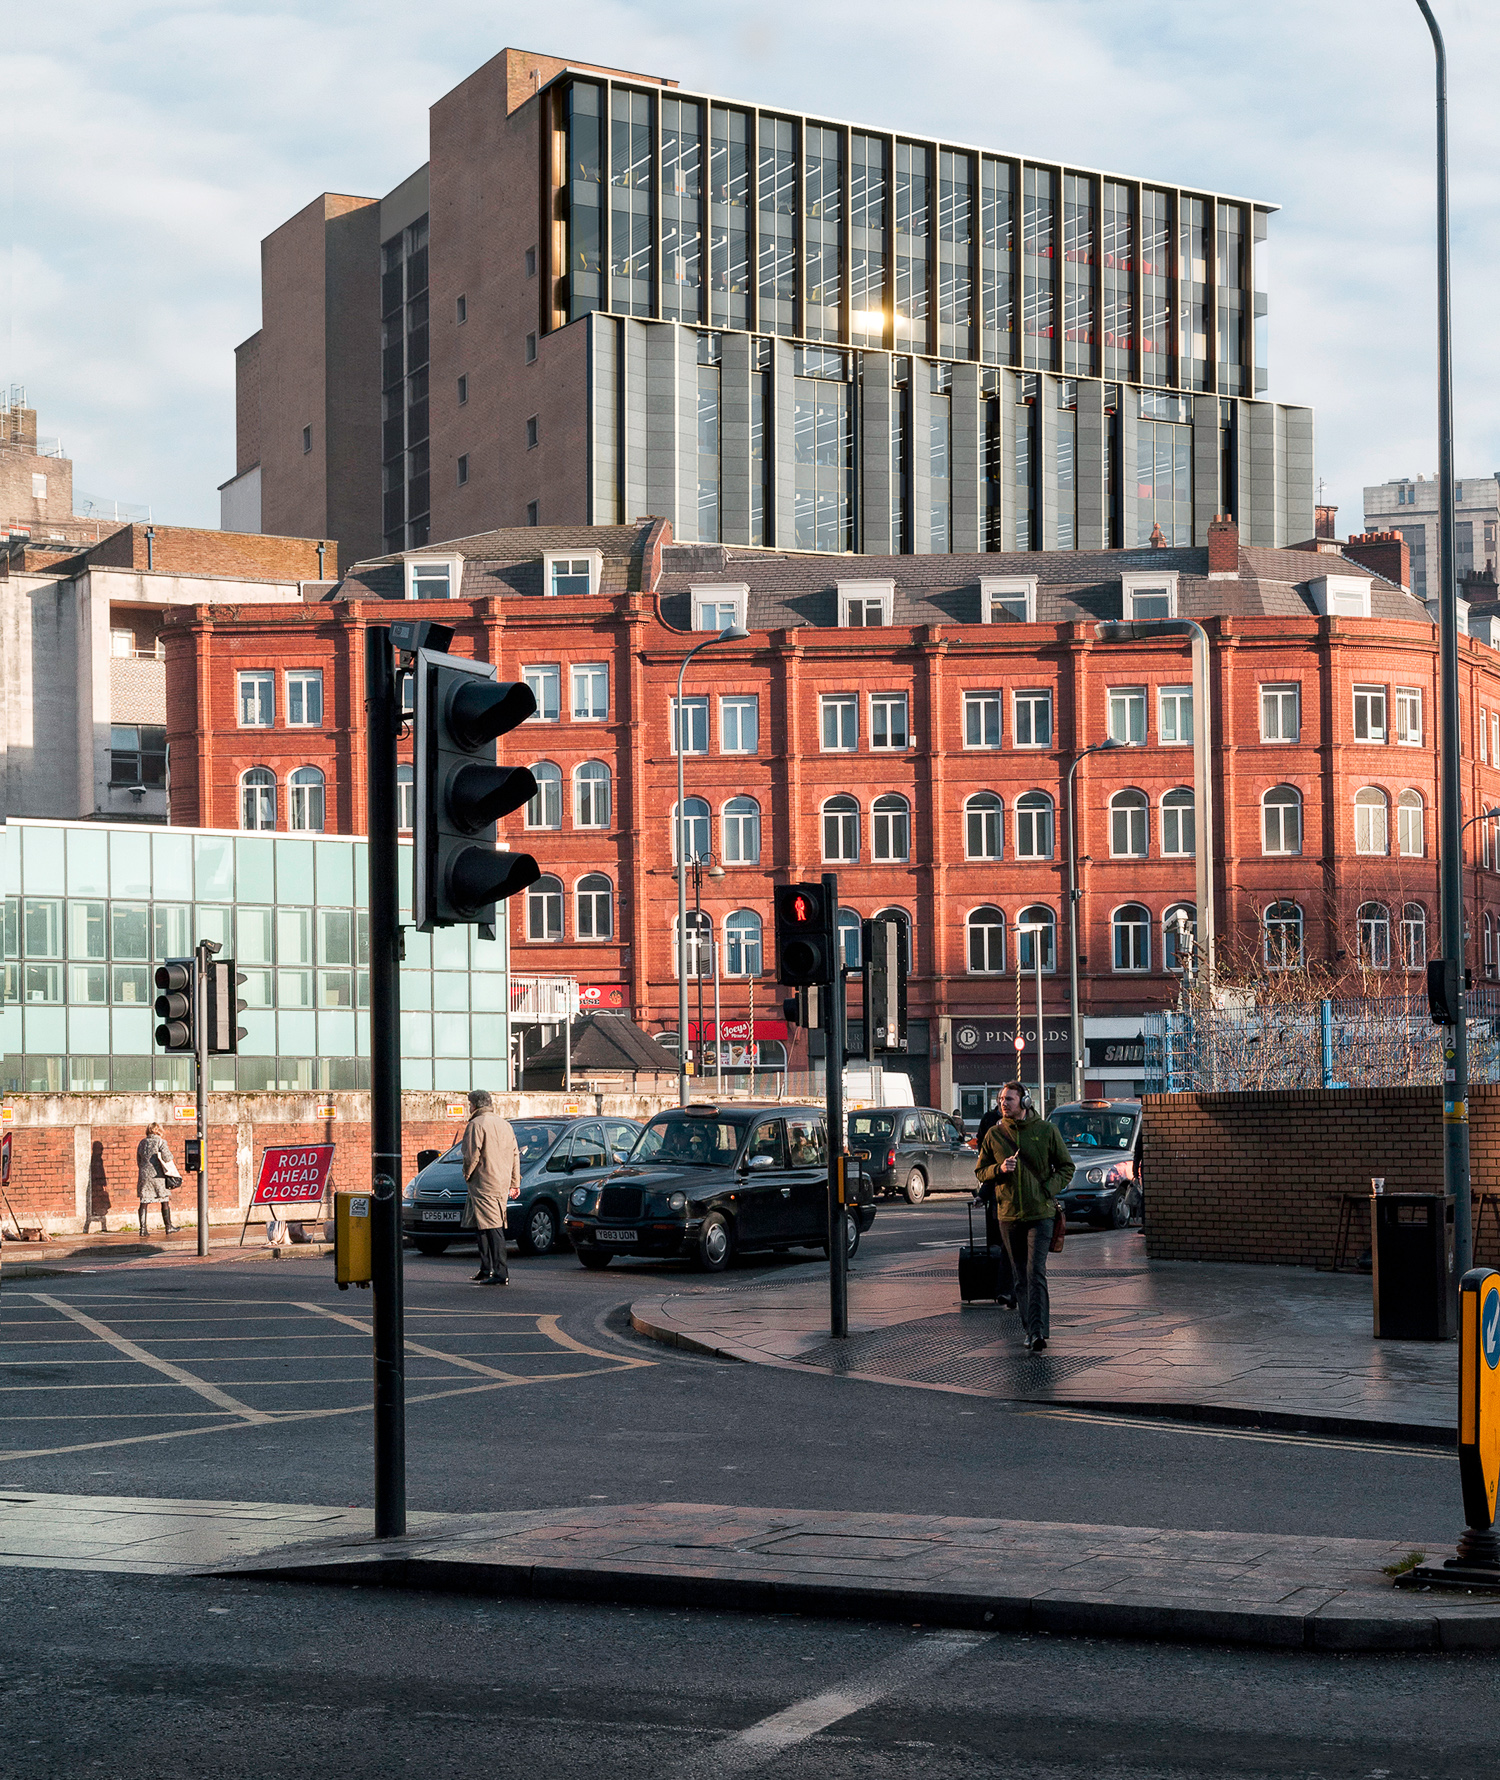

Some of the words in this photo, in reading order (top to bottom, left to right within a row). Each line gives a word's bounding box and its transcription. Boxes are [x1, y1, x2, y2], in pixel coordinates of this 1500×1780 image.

[723, 1023, 747, 1037] Joeys
[985, 1030, 1068, 1042] PINODS
[1105, 1045, 1144, 1061] SAND
[278, 1152, 317, 1167] ROAD
[269, 1168, 319, 1183] AHEAD
[262, 1184, 319, 1198] CLOSED
